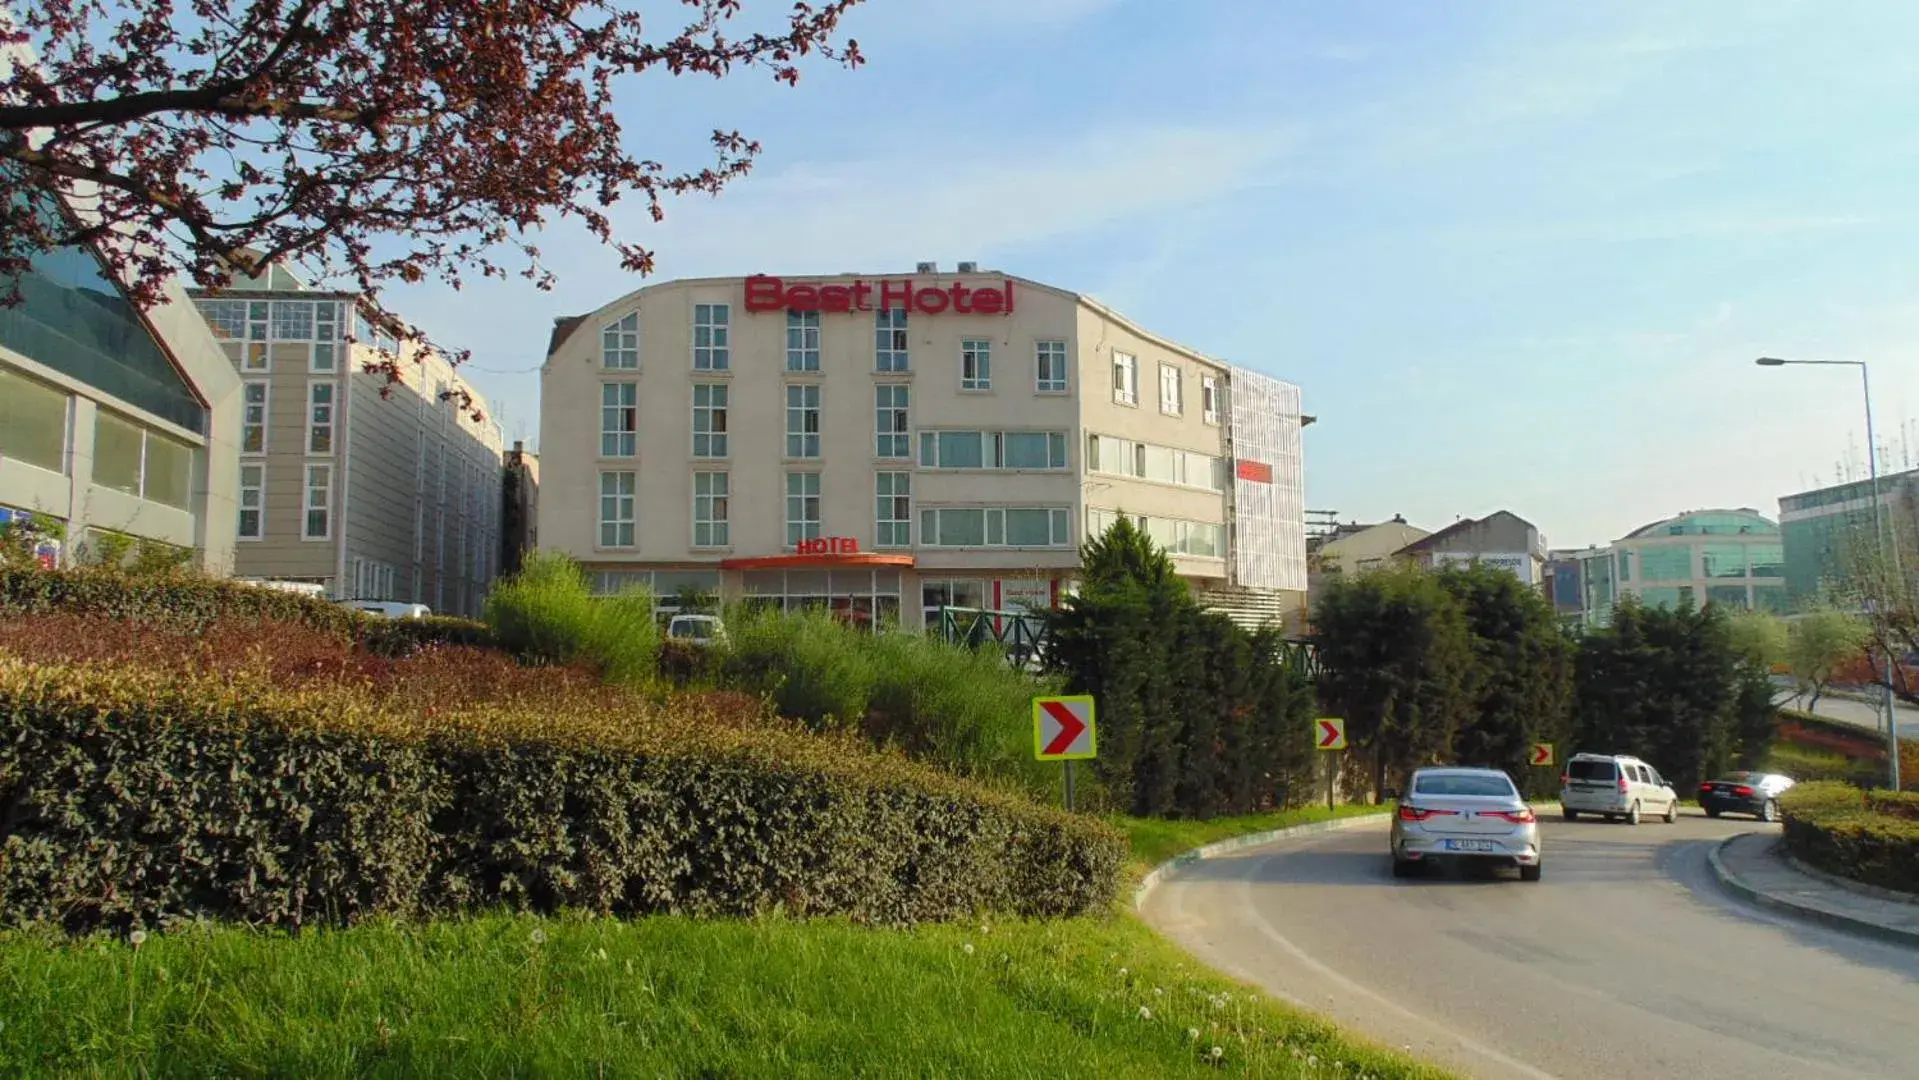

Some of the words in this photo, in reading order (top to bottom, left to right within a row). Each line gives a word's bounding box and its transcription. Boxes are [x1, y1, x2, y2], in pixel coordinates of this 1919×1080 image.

[745, 276, 872, 312] Best
[880, 280, 1014, 313] Hotel
[797, 537, 858, 554] HOTEL
